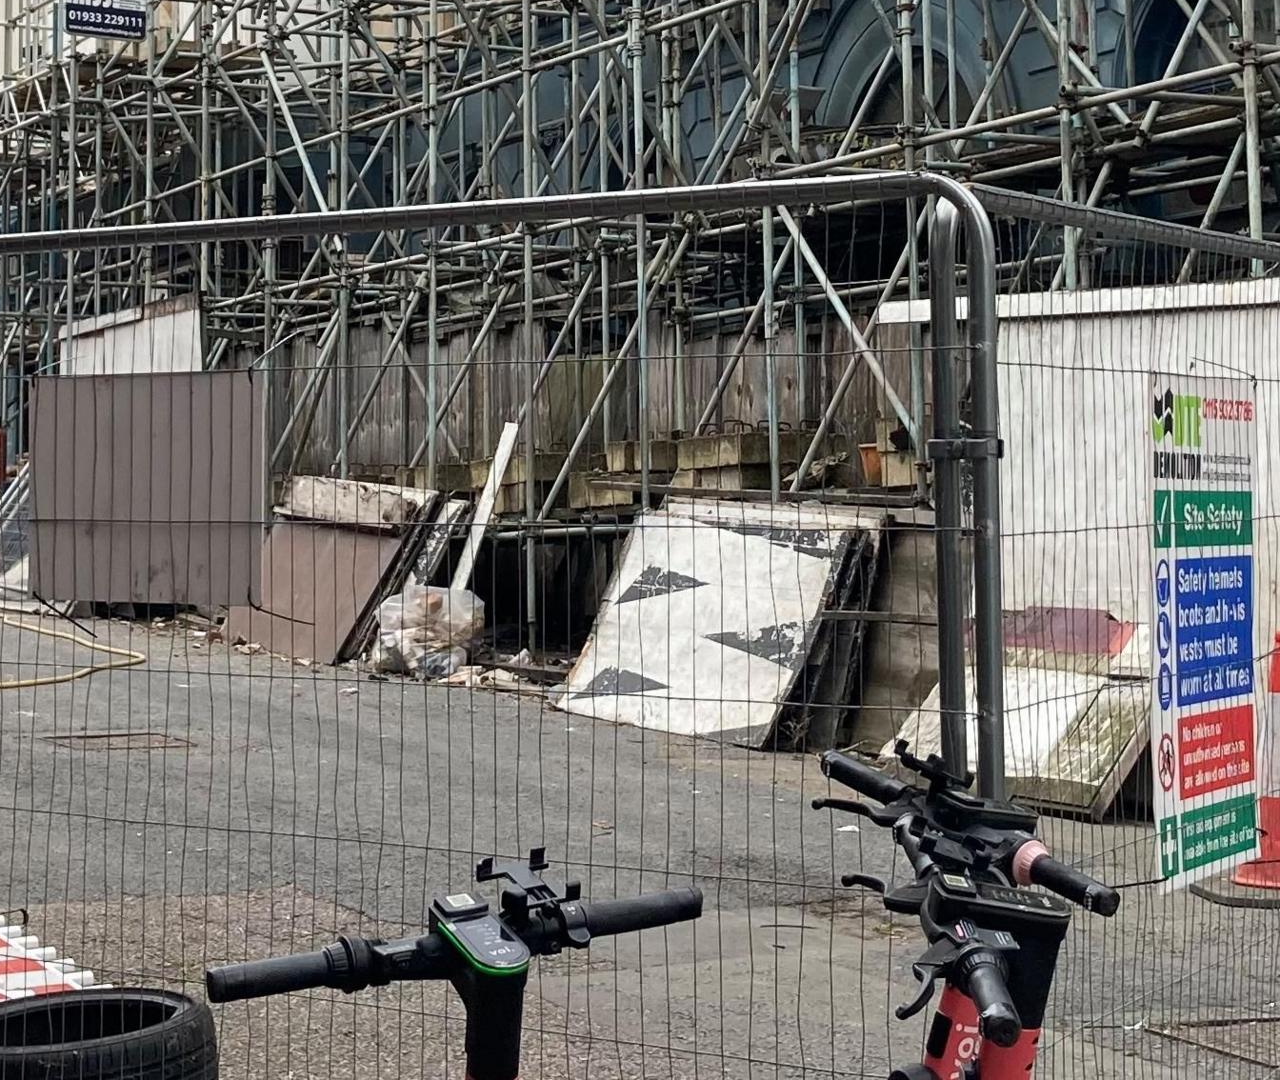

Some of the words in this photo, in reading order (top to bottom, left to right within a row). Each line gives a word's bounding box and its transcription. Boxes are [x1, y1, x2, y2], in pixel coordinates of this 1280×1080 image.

[69, 9, 102, 24] 01933
[105, 14, 143, 28] 229111
[1154, 451, 1201, 480] DEMOLITION
[1184, 502, 1204, 531] Site
[1207, 503, 1243, 536] Safety
[1178, 567, 1207, 596] Safety
[1222, 597, 1246, 622] h-vis
[1179, 637, 1203, 662] vests
[1204, 633, 1226, 659] must
[1227, 632, 1238, 655] be
[1203, 669, 1213, 693] at
[1226, 664, 1250, 688] times
